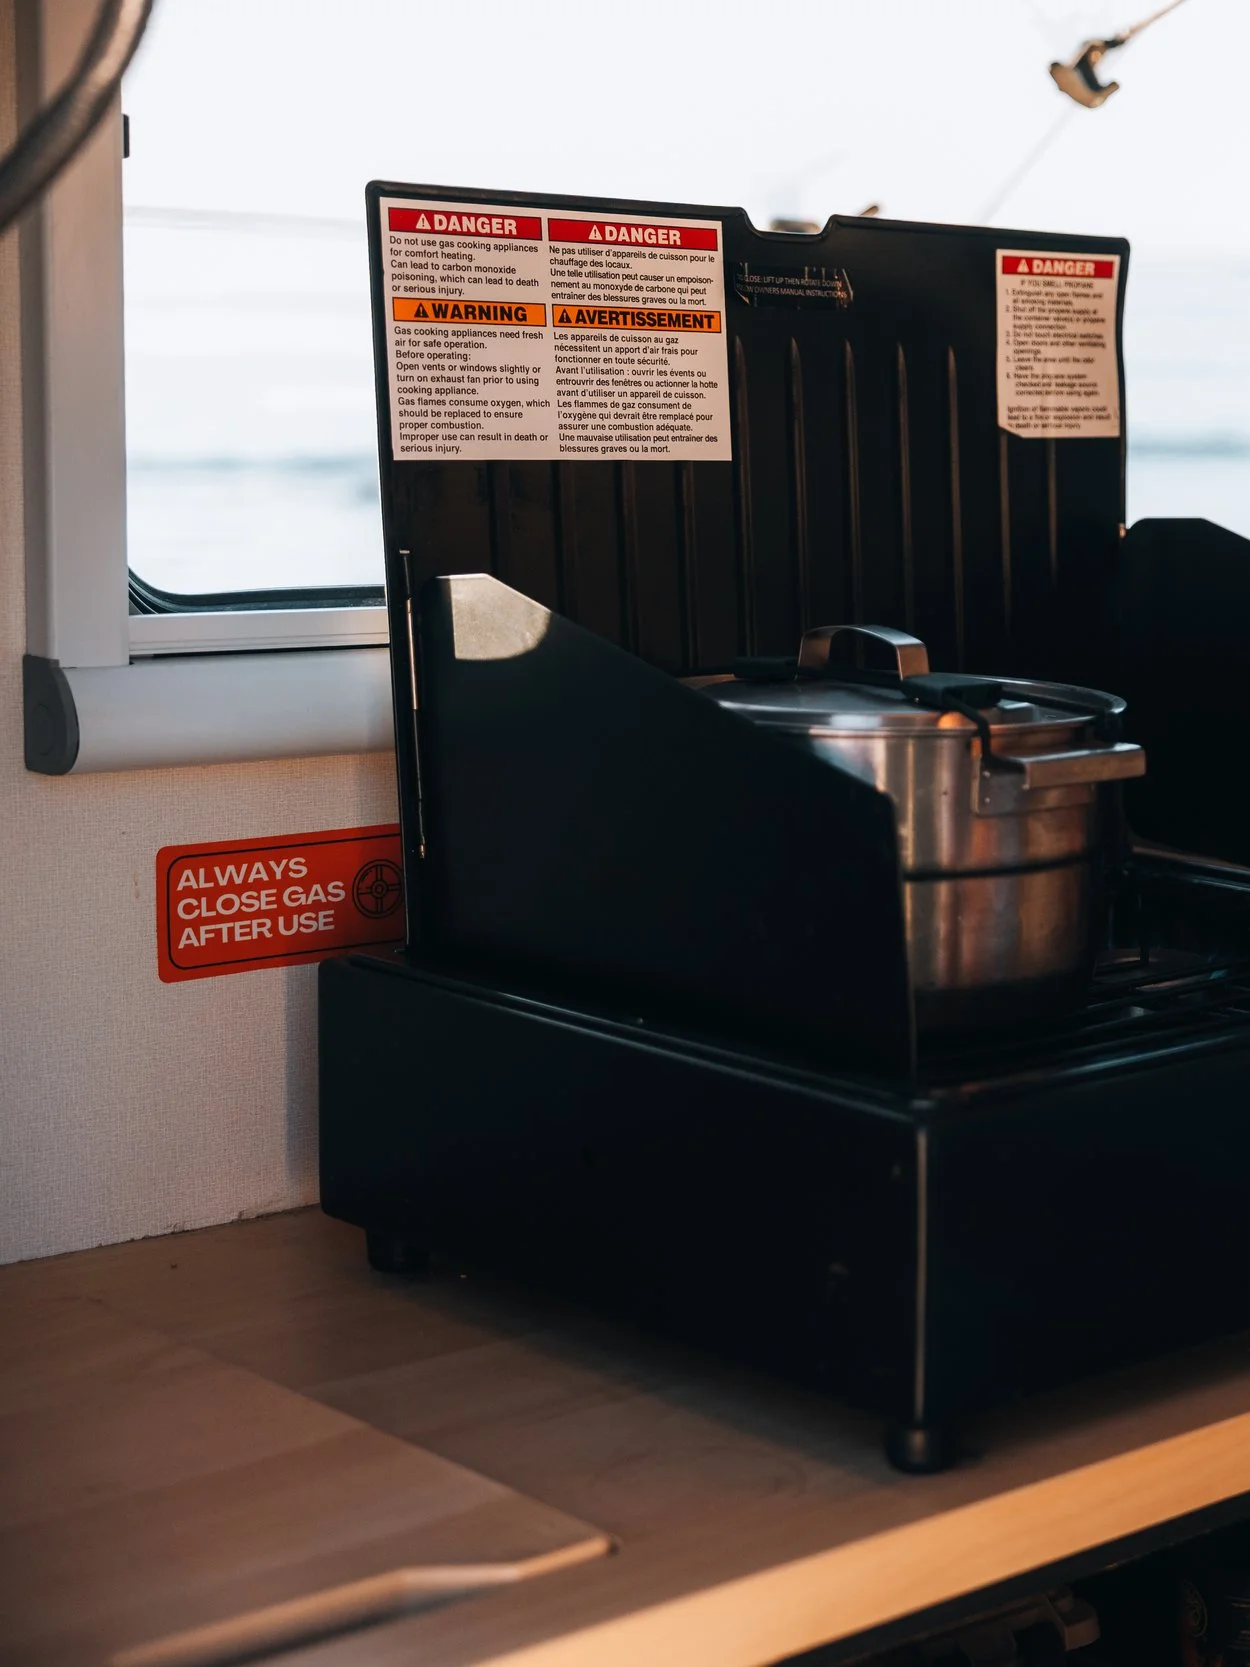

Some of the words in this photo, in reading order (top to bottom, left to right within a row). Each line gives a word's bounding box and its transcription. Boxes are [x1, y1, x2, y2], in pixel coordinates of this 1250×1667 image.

[434, 214, 517, 235] DANGER
[605, 226, 681, 245] DANGER
[390, 236, 402, 245] Do
[404, 237, 418, 246] not
[421, 239, 437, 247] use
[439, 240, 455, 249] gas
[456, 240, 491, 252] cooking
[493, 242, 538, 253] appliances
[390, 247, 402, 256] for
[404, 249, 439, 259] comfort
[441, 250, 476, 262] heating.
[549, 245, 560, 254] Ne
[561, 248, 576, 256] pas
[577, 247, 604, 256] utiliser
[605, 249, 646, 260] d'appareils
[659, 252, 688, 261] cuisson
[689, 255, 707, 263] pour
[390, 259, 408, 268] Can
[410, 260, 428, 270] lead
[442, 262, 472, 272] carbon
[474, 265, 516, 274] monoxide
[549, 257, 588, 269] chauffage
[605, 259, 632, 269] locaux.
[1032, 259, 1095, 276] DANGER
[391, 272, 437, 284] poisoning,
[439, 274, 465, 283] which
[467, 276, 483, 284] can
[485, 276, 503, 285] lead
[515, 277, 539, 287] death
[550, 268, 566, 277] Une
[567, 269, 583, 278] telle
[584, 270, 620, 280] utilisation
[621, 271, 638, 282] peut
[639, 274, 664, 282] causer
[403, 284, 436, 294] serious
[438, 285, 464, 297] injury.
[550, 281, 580, 289] nement
[593, 282, 633, 293] monoxyde
[645, 284, 676, 294] carbone
[690, 287, 706, 296] peut
[603, 293, 640, 303] blessures
[641, 296, 667, 305] graves
[433, 303, 527, 323] WARNING
[575, 309, 714, 329] AVERTISSEMENT
[394, 326, 412, 335] Gas
[414, 327, 449, 338] cooking
[451, 328, 497, 339] appliances
[499, 330, 520, 338] need
[522, 330, 543, 339] fresh
[553, 332, 568, 340] Les
[570, 333, 607, 343] appareils
[620, 334, 652, 343] cuisson
[665, 337, 679, 346] gaz
[395, 338, 406, 347] air
[408, 338, 421, 347] for
[423, 339, 442, 348] safe
[443, 340, 487, 350] operation.
[554, 343, 600, 352] nécessitent
[614, 345, 640, 355] apport
[642, 346, 659, 354] d'air
[661, 346, 678, 355] frais
[680, 348, 698, 357] pour
[396, 350, 424, 359] Before
[426, 351, 471, 362] operating:
[554, 354, 601, 364] fonctionner
[614, 356, 635, 365] toute
[637, 356, 670, 366] sécurité.
[396, 361, 419, 372] Open
[422, 363, 446, 371] vents
[459, 363, 497, 372] windows
[499, 364, 530, 375] slightly
[555, 366, 579, 374] Avant
[580, 366, 624, 376] l'utilisation
[631, 368, 654, 376] ouvrir
[669, 368, 695, 377] évents
[396, 374, 414, 382] turn
[430, 374, 465, 383] exhaust
[466, 375, 481, 383] fan
[483, 375, 503, 386] prior
[516, 376, 539, 387] using
[556, 377, 594, 386] entrouvrir
[611, 378, 642, 387] fenêtres
[655, 379, 690, 388] actionner
[699, 380, 718, 388] hotte
[397, 385, 432, 396] cooking
[434, 386, 479, 396] appliance.
[556, 389, 579, 397] avant
[580, 389, 616, 398] d'utiliser
[630, 390, 661, 400] appareil
[674, 390, 706, 399] cuisson.
[398, 397, 415, 406] Gas
[417, 397, 446, 406] flames
[448, 399, 488, 407] consume
[490, 400, 524, 409] oxygen,
[526, 399, 550, 408] which
[557, 399, 572, 408] Les
[574, 400, 608, 409] flammes
[621, 402, 636, 411] gaz
[637, 402, 680, 410] consument
[399, 408, 428, 418] should
[444, 409, 481, 420] replaced
[558, 411, 597, 422] l'oxygène
[613, 411, 640, 420] devrait
[642, 412, 657, 420] être
[659, 412, 694, 422] remplacé
[696, 414, 713, 422] pour
[399, 422, 428, 431] proper
[430, 421, 484, 429] combustion.
[608, 422, 654, 431] combustion
[656, 423, 693, 433] adéquate.
[400, 432, 439, 443] Improper
[478, 432, 502, 441] result
[514, 432, 538, 441] death
[559, 433, 575, 442] Une
[576, 433, 613, 442] mauvaise
[614, 433, 652, 442] utilisation
[652, 434, 670, 444] peut
[400, 444, 433, 452] serious
[435, 444, 462, 454] injury.
[559, 443, 599, 452] blessures
[600, 446, 628, 454] graves
[650, 445, 670, 453] mort.
[176, 857, 308, 891] ALWAYS
[177, 889, 277, 920] CLOSE
[283, 881, 346, 907] GAS
[178, 918, 273, 949] AFTER
[278, 910, 335, 936] USE
